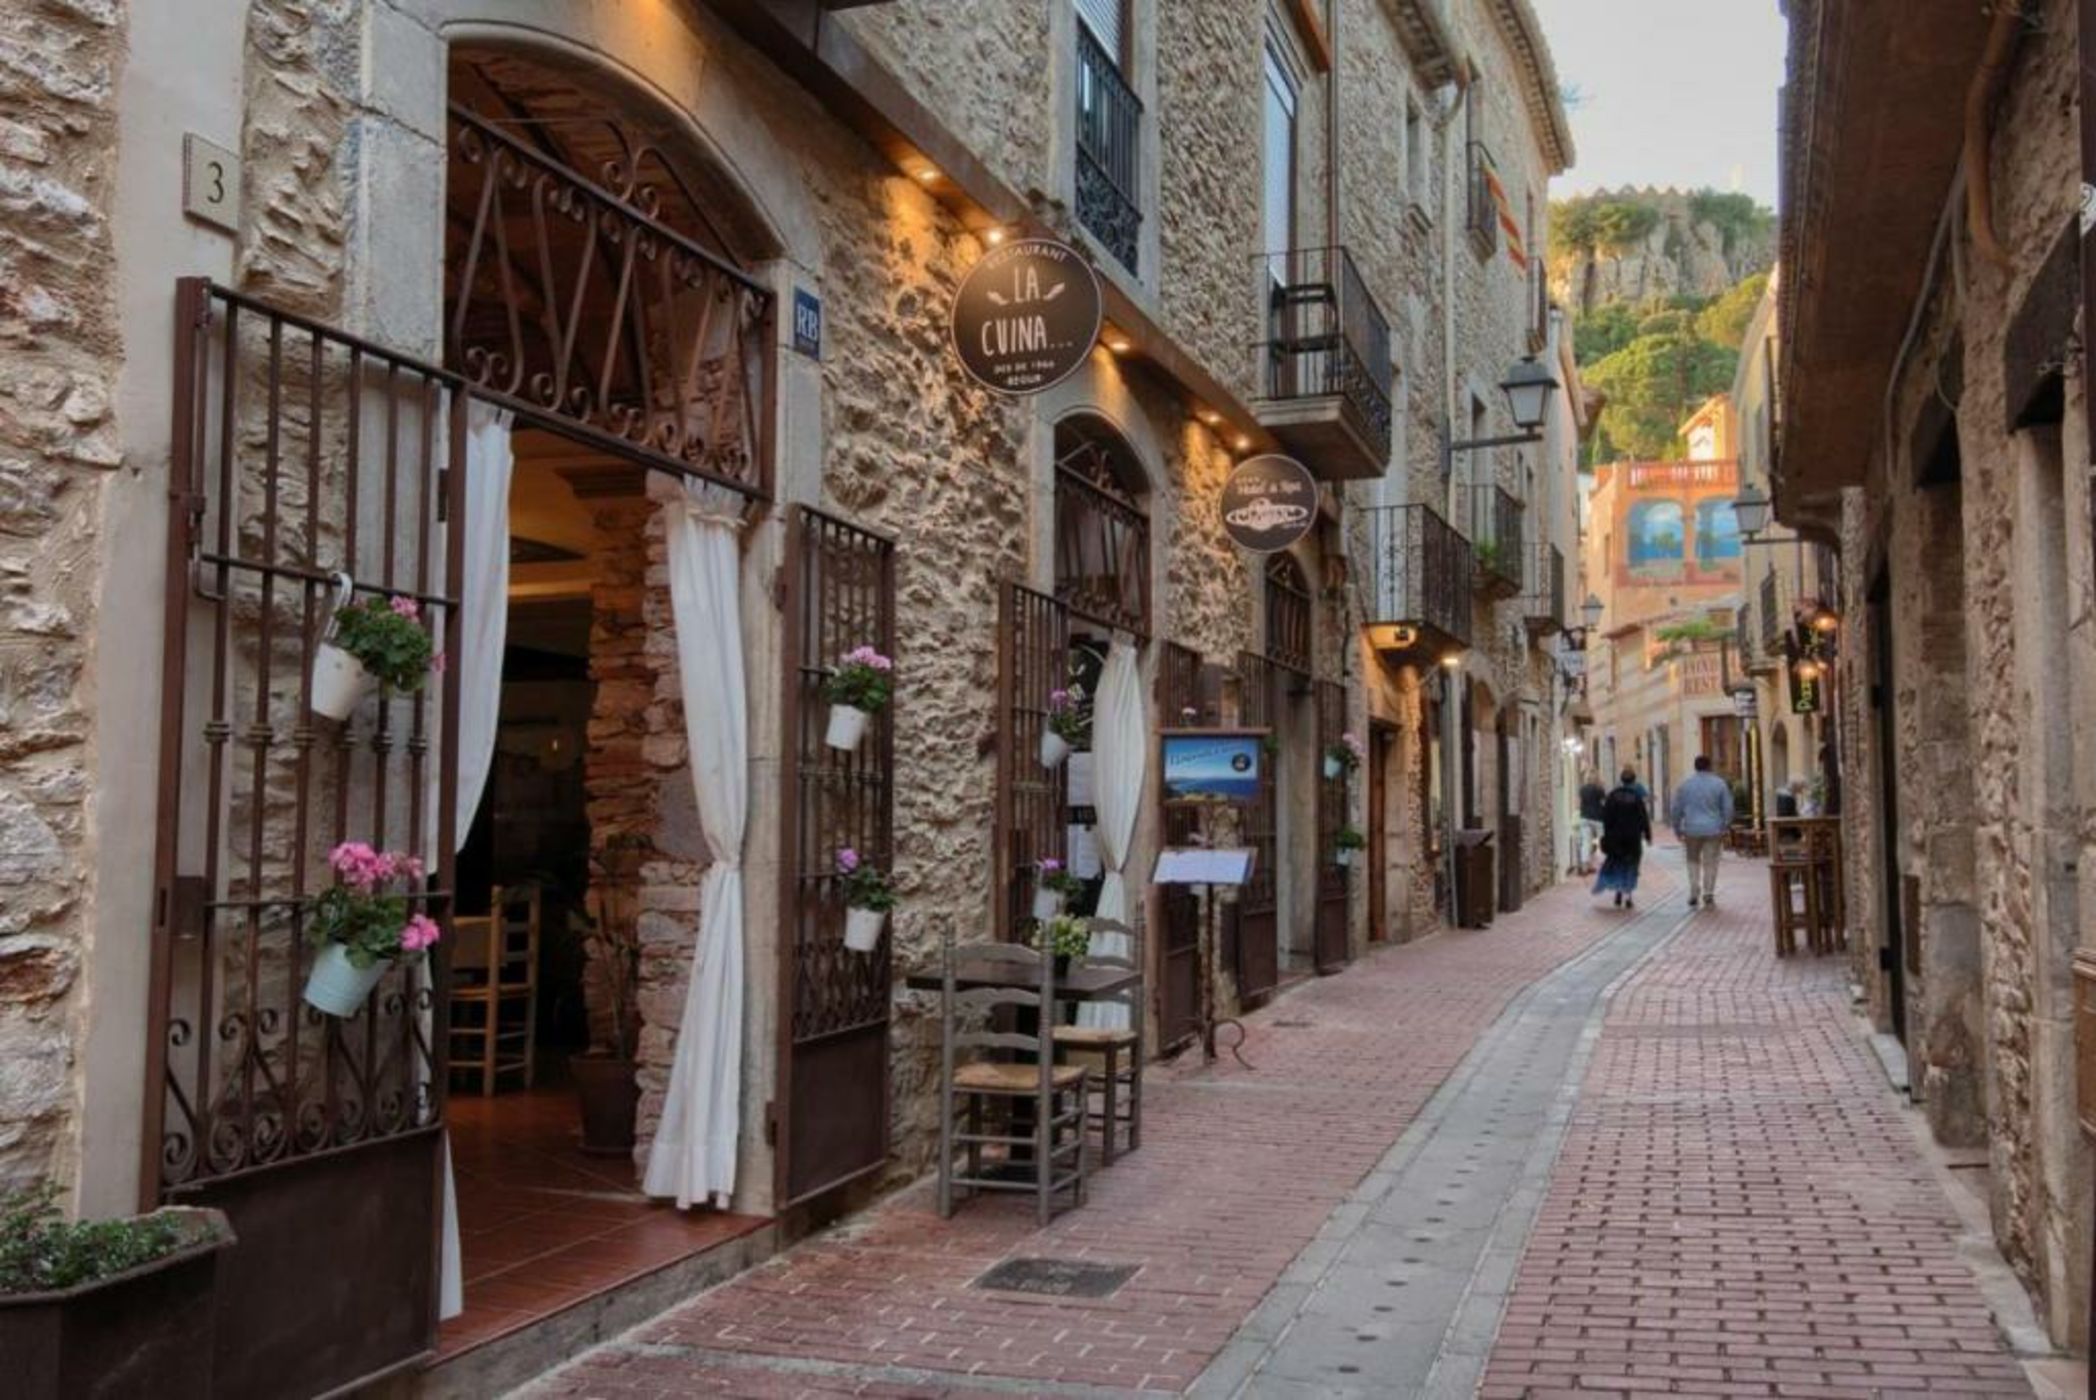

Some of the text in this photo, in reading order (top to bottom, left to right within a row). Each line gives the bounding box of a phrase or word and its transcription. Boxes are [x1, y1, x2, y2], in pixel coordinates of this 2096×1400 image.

[207, 161, 224, 204] 3
[1013, 265, 1040, 303] LA
[797, 303, 818, 341] RB
